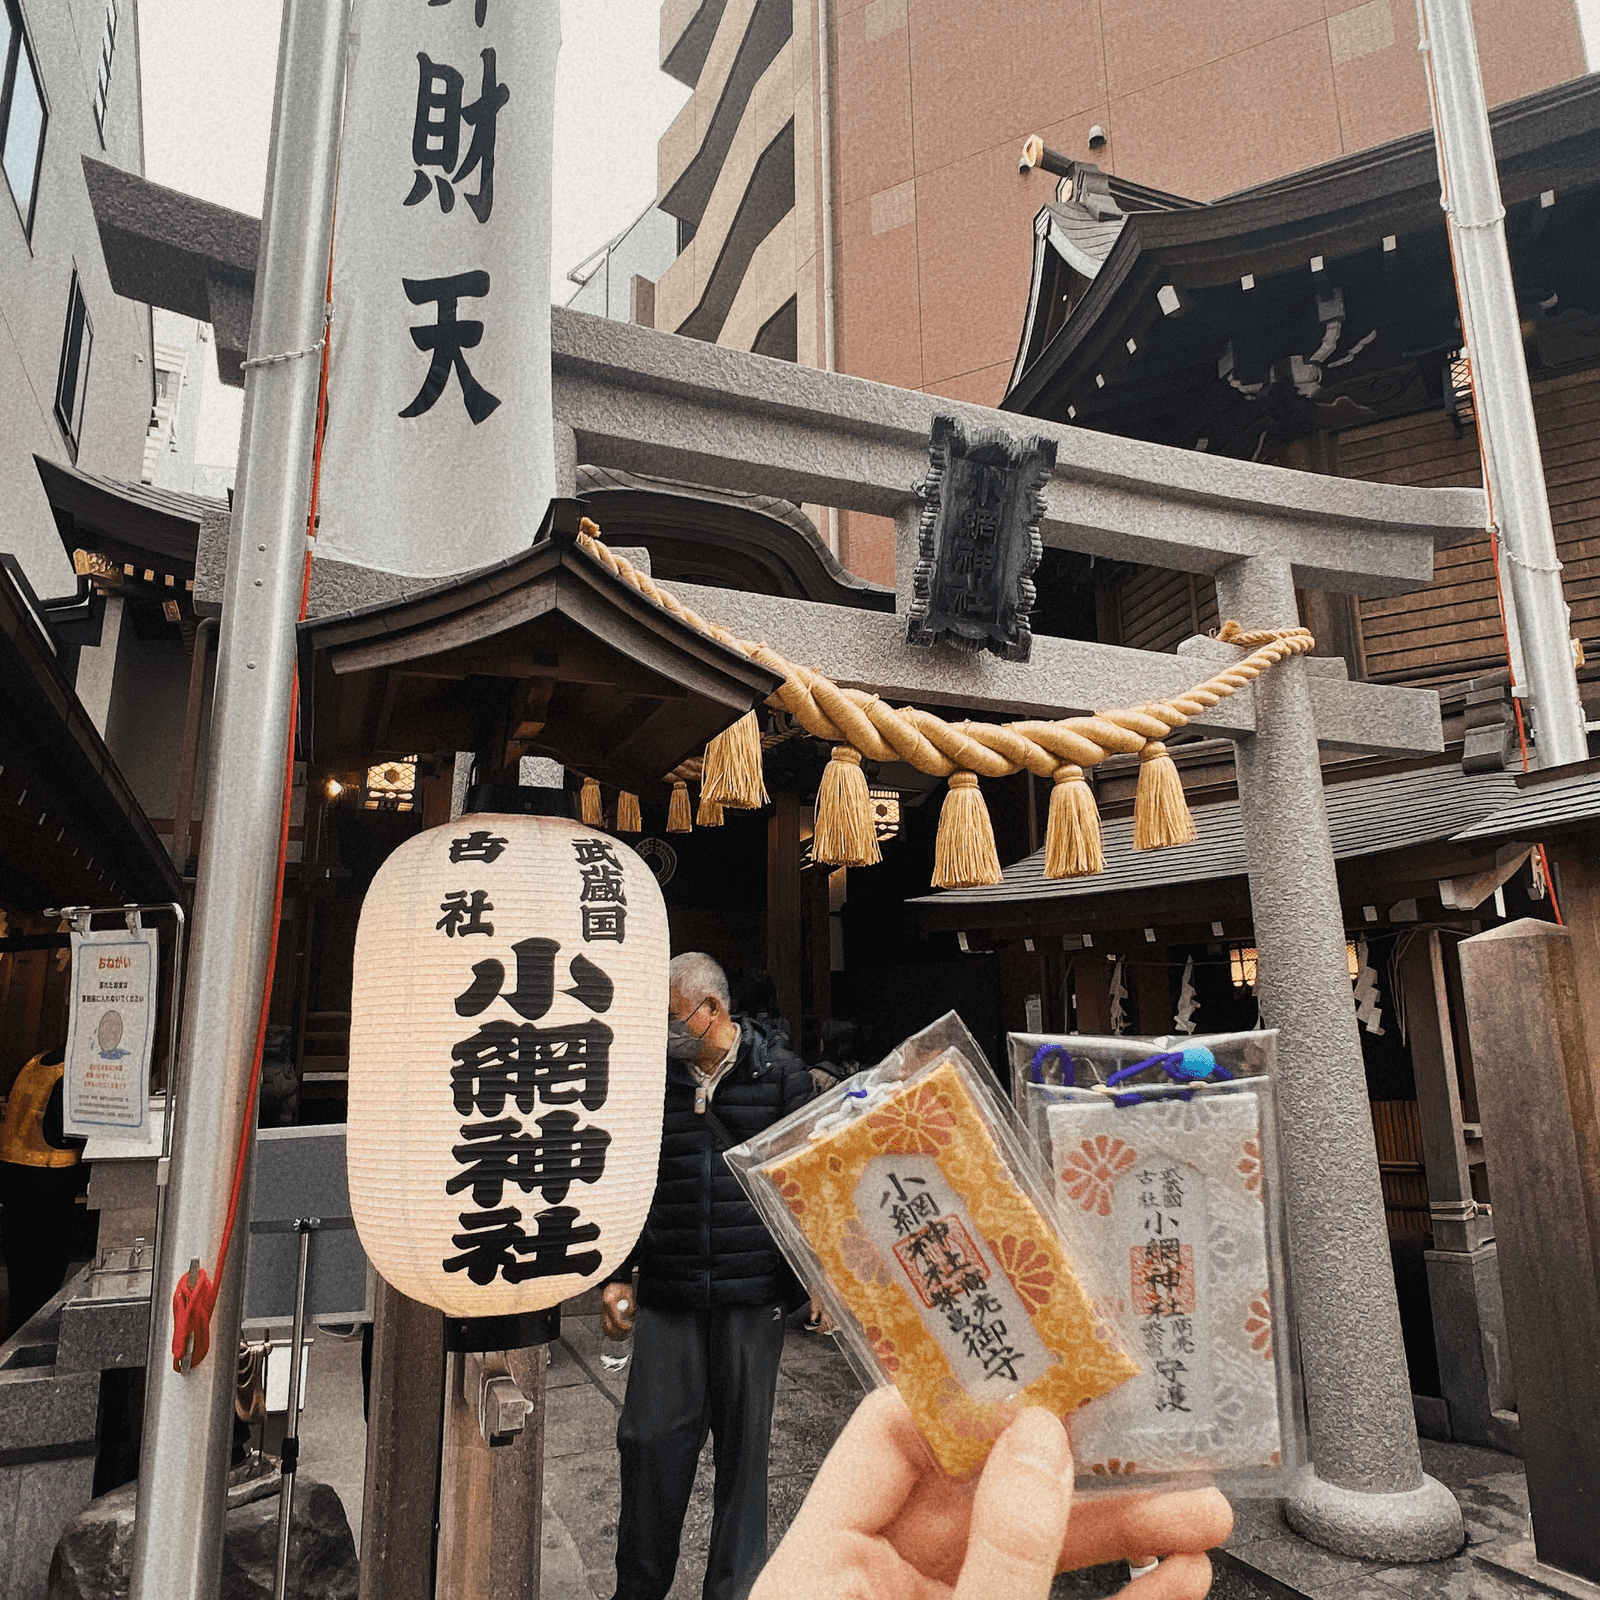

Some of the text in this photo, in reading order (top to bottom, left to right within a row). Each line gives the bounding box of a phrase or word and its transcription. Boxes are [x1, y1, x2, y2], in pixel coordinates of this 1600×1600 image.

[399, 0, 510, 426] 財天
[436, 831, 508, 938] 古社
[571, 838, 628, 944] 武蔵国
[98, 955, 132, 970] おねがい
[442, 937, 615, 1286] 小網神社
[880, 1172, 971, 1289] 小網神社
[1144, 1210, 1184, 1320] 小網神社
[962, 1318, 1025, 1381] 御守
